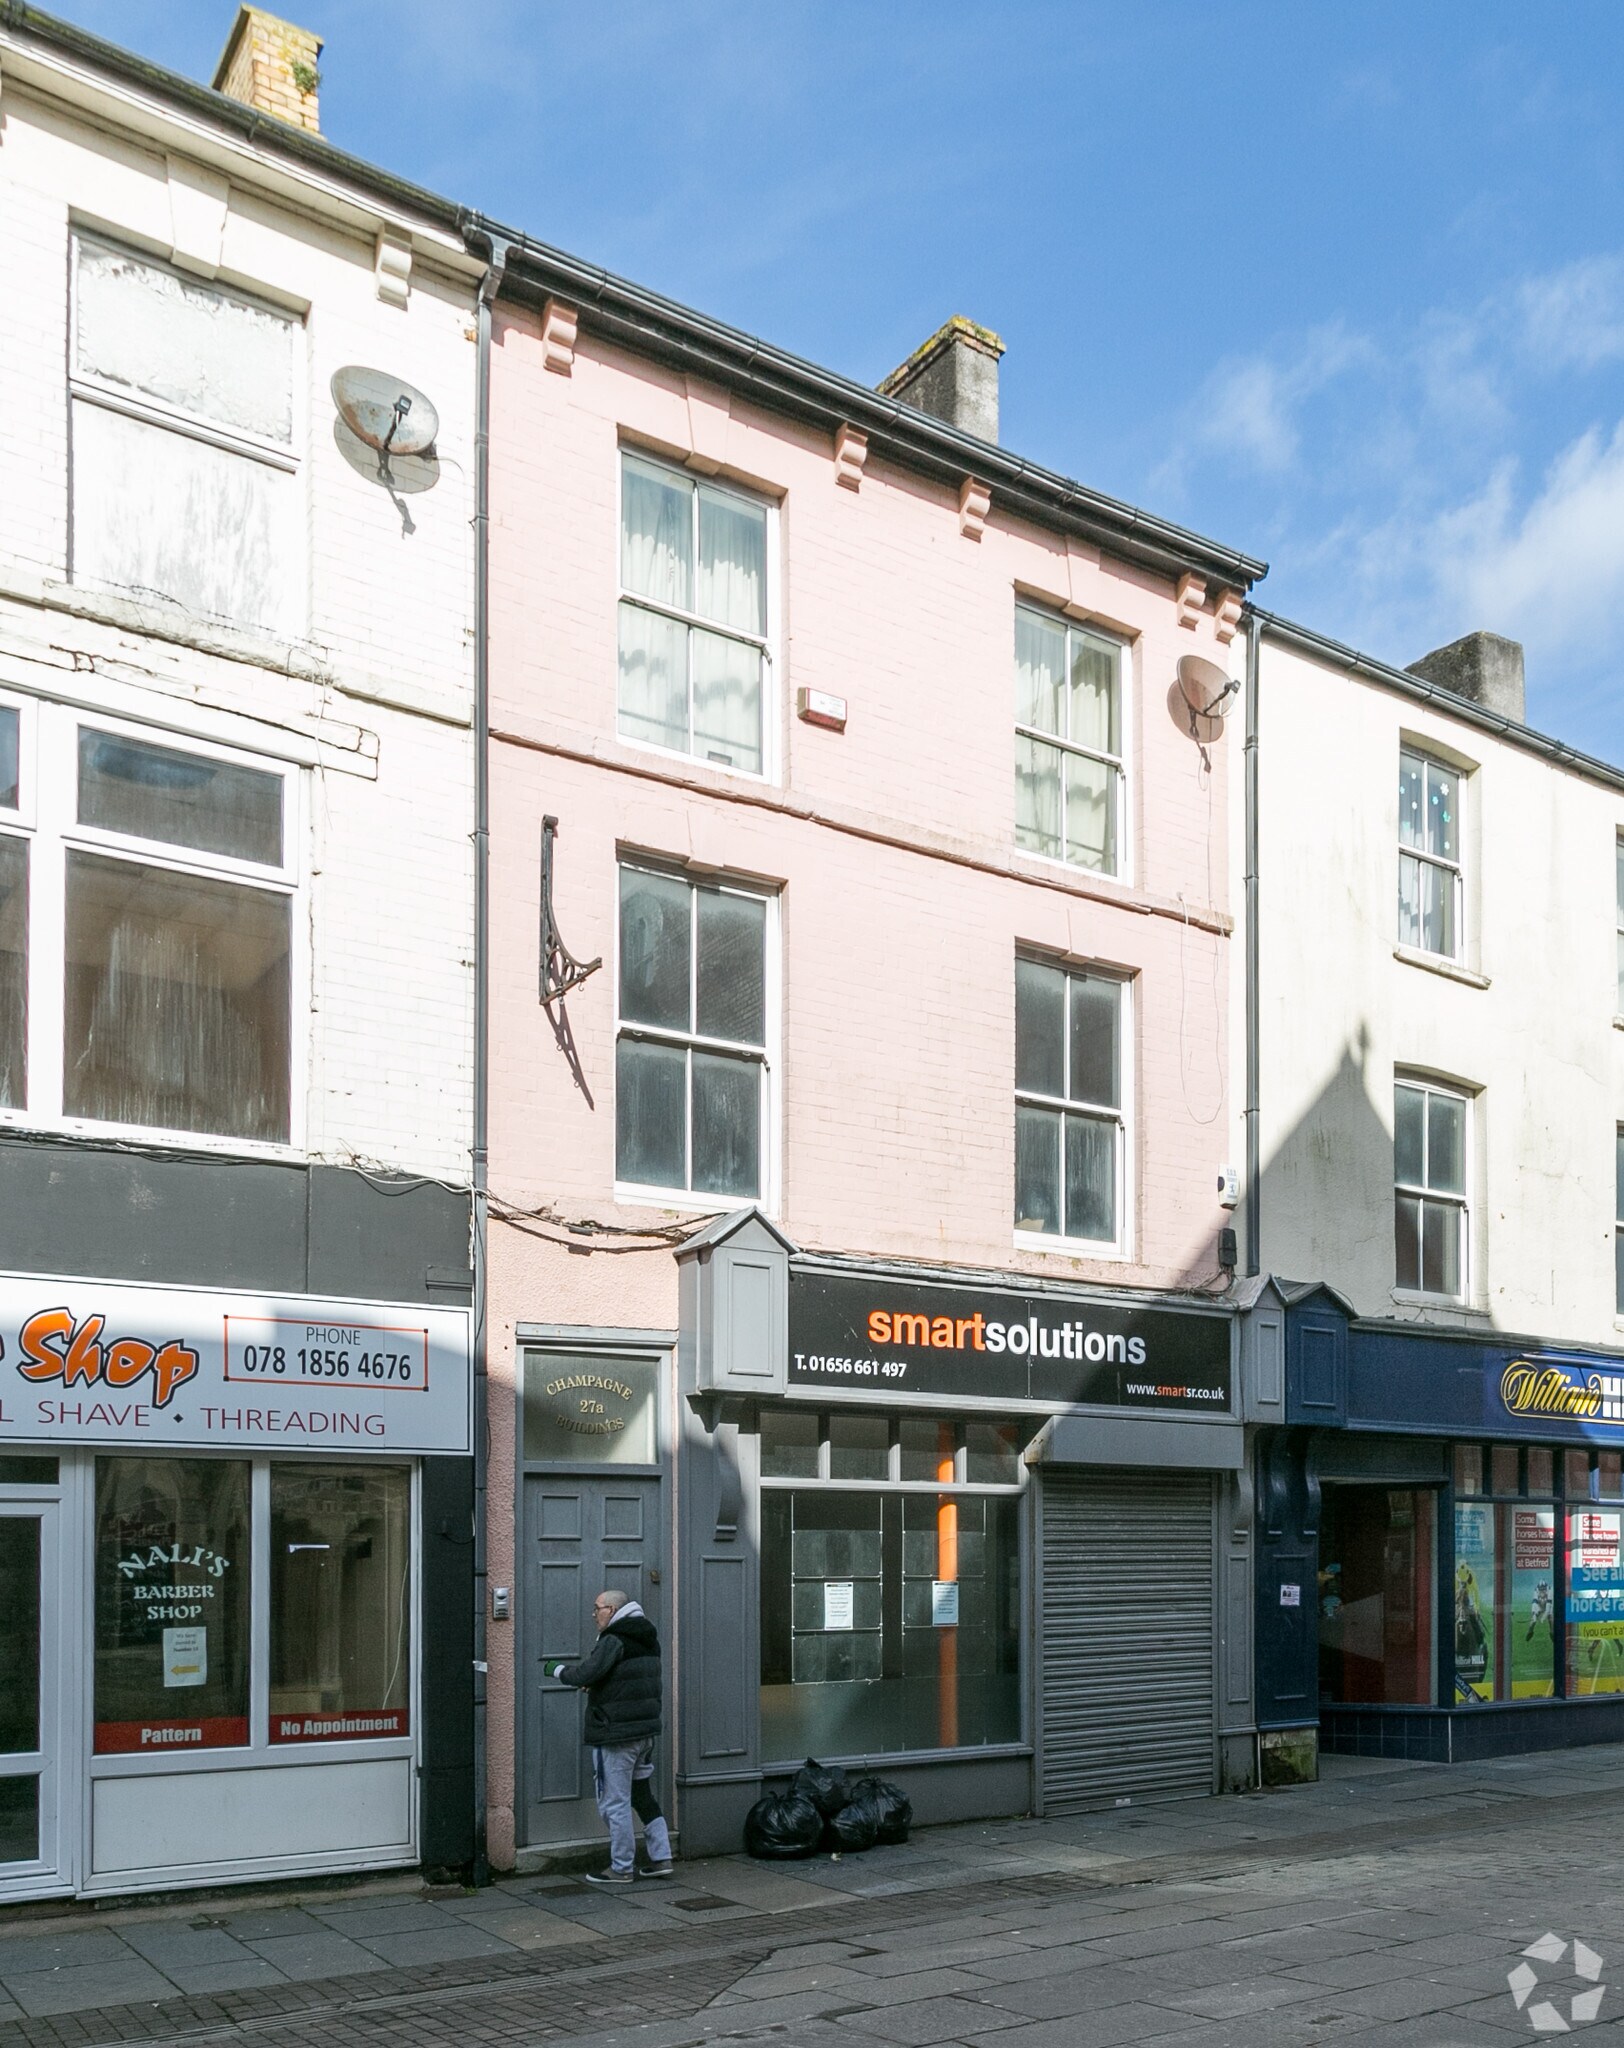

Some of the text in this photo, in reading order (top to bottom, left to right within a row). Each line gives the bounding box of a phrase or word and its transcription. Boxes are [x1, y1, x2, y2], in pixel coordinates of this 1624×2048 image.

[306, 1326, 361, 1346] PHONE
[868, 1310, 1146, 1365] smartsolutions
[16, 1307, 199, 1409] Shop
[243, 1345, 411, 1381] 078 1856 4676
[794, 1354, 907, 1378] T. 01656 661 497
[546, 1375, 632, 1400] CHAMPAGNE
[1127, 1384, 1224, 1400] www.smartsr.co.uk
[1500, 1361, 1603, 1417] William
[579, 1399, 604, 1414] 27a
[38, 1400, 150, 1427] SHAVE
[200, 1407, 386, 1435] THREADING
[556, 1415, 625, 1434] BUILDINGS
[1516, 1515, 1535, 1524] Some
[1516, 1529, 1538, 1539] horses
[117, 1543, 230, 1578] NALI'S
[1516, 1558, 1549, 1567] at Betfred
[1582, 1563, 1608, 1581] See
[134, 1585, 215, 1599] BARBER
[147, 1605, 202, 1619] SHOP
[1570, 1593, 1610, 1613] horse
[141, 1726, 202, 1744] Pattern
[280, 1716, 398, 1736] No Appointment
